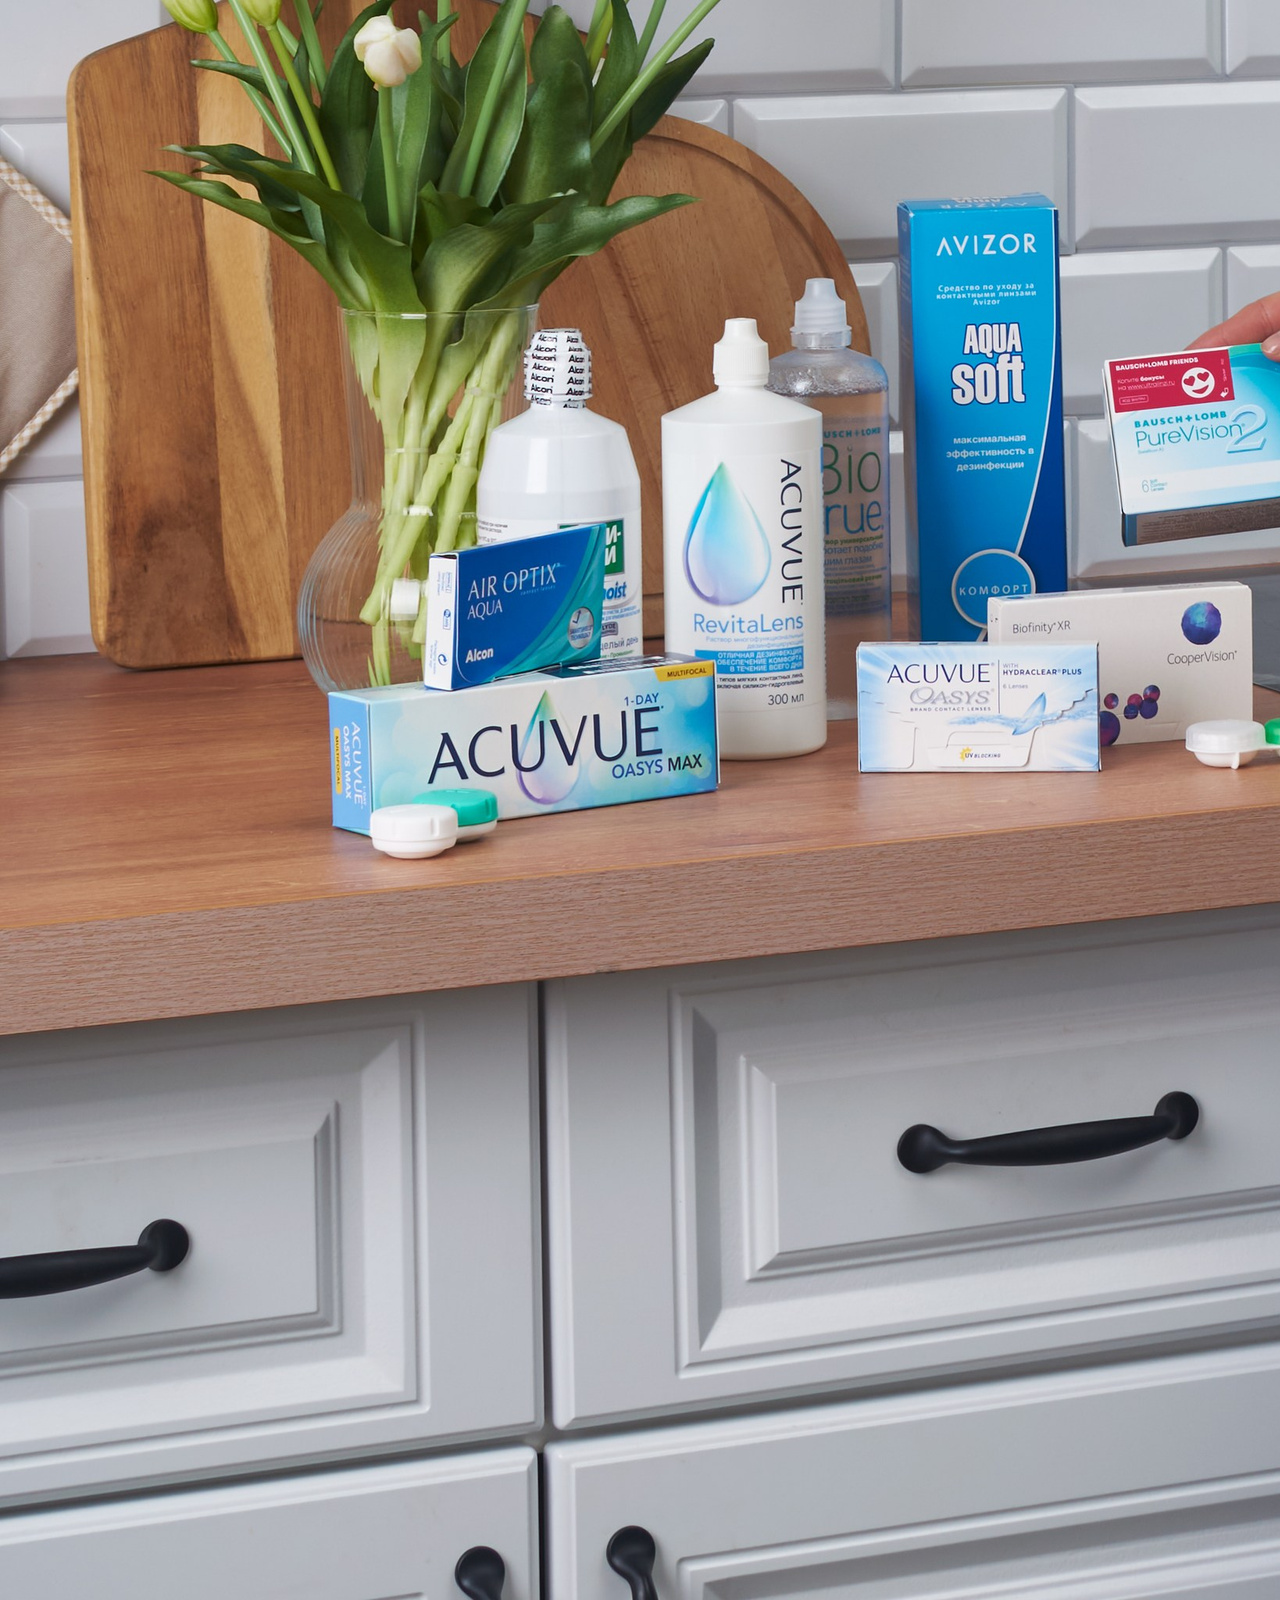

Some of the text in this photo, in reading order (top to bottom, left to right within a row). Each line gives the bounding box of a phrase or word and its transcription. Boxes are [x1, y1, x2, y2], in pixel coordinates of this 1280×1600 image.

[936, 232, 1037, 257] AVIZOR
[936, 290, 1037, 300] контактными линзами
[937, 284, 980, 293] Средство
[996, 283, 1022, 291] уходу
[972, 298, 1001, 306] Avizor
[962, 322, 1023, 358] AQUA
[1115, 357, 1199, 371] BAUSCH+LOMB FRIENDS
[951, 353, 1026, 405] soft
[953, 434, 1027, 444] максимальная
[1135, 422, 1243, 448] PureVision
[946, 447, 1026, 458] эффективность
[956, 461, 1025, 472] дезинфекции
[1141, 479, 1149, 493] 6
[824, 501, 884, 536] rue
[780, 458, 803, 604] ACUVUE
[467, 575, 498, 601] AIR
[503, 564, 557, 593] OPTIX
[959, 583, 1028, 596] КОМФОРТ
[467, 599, 503, 621] AQUA
[694, 613, 804, 634] RevitaLens
[1012, 620, 1071, 634] Biofinity XR
[465, 648, 494, 664] Alcon
[717, 658, 767, 666] ОБЕСПЕЧЕНИЕ
[1167, 651, 1236, 666] CooperVision
[667, 668, 706, 677] MULTIFOCAL
[736, 664, 767, 672] ТЕЧЕНИЕ
[768, 663, 789, 671] ВСЕГО
[886, 663, 991, 684] ACUVUE
[624, 692, 660, 706] 1-DAY
[768, 693, 788, 706] 300
[343, 725, 351, 767] OASYS
[427, 705, 664, 784] ACUVUE
[351, 721, 363, 805] ACUVUE
[611, 753, 703, 779] OASYS MAX
